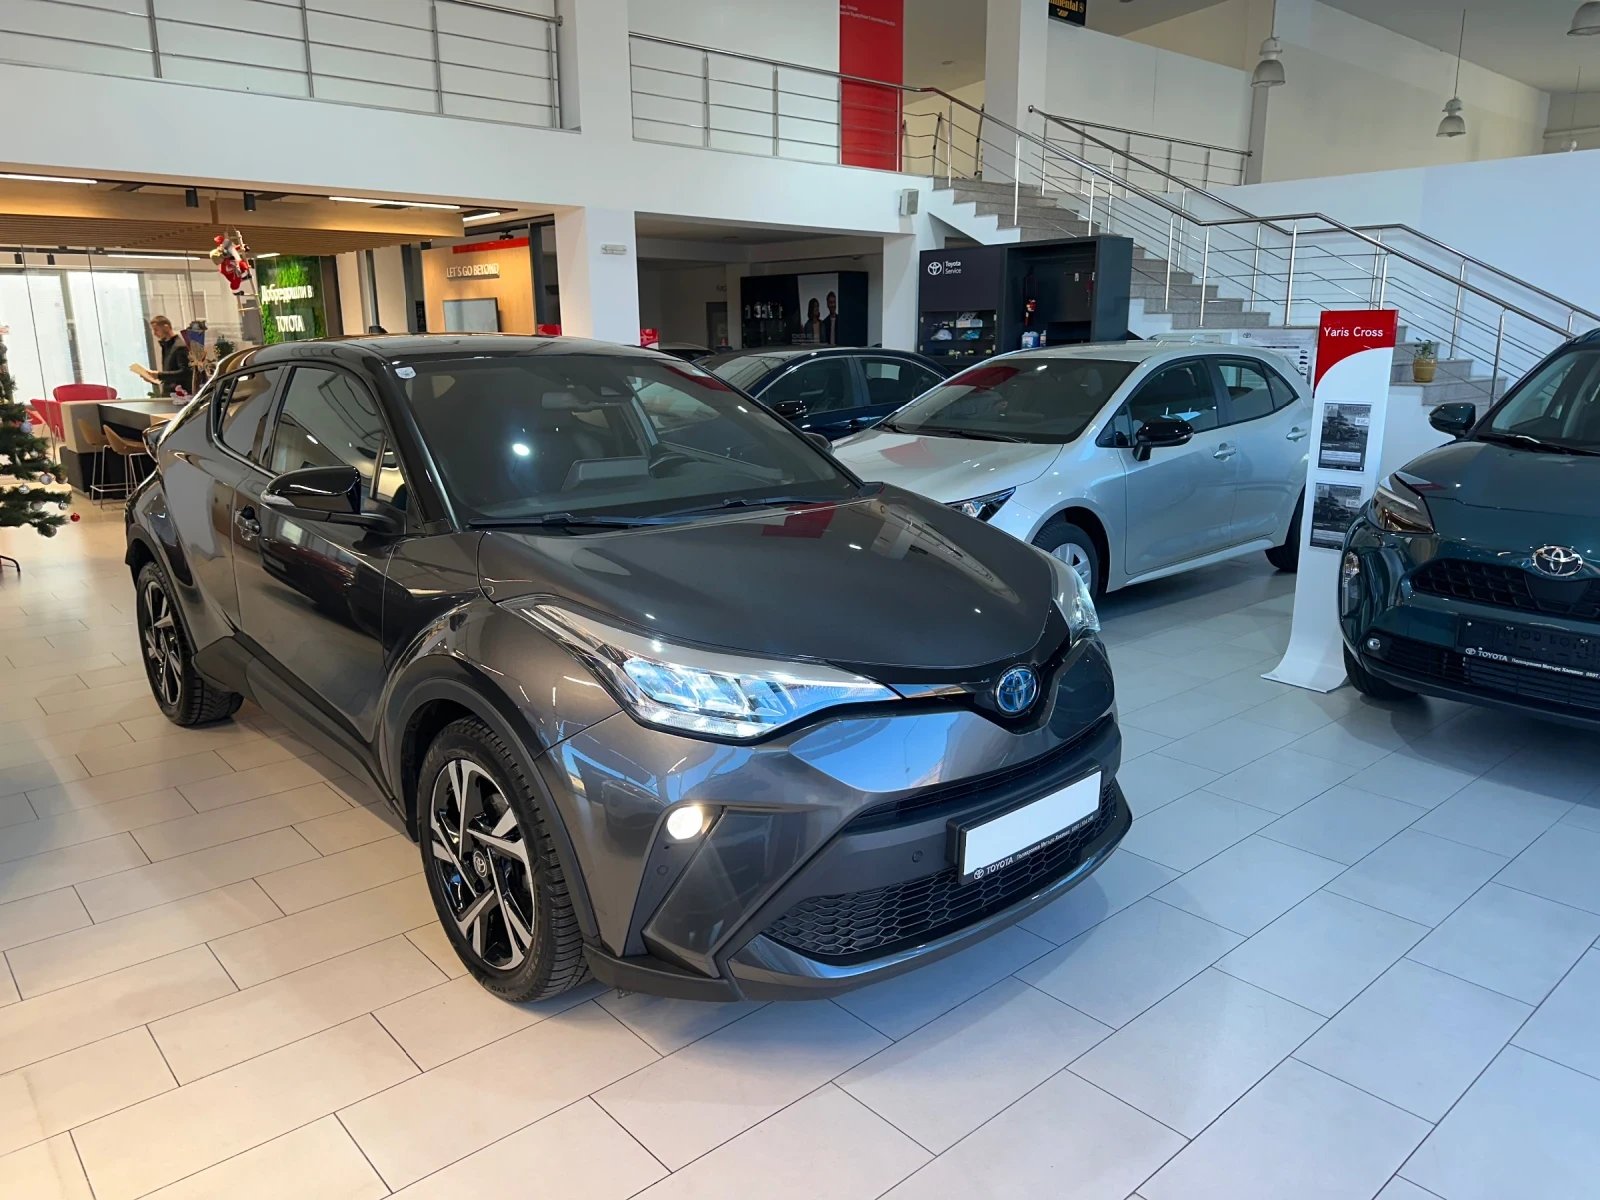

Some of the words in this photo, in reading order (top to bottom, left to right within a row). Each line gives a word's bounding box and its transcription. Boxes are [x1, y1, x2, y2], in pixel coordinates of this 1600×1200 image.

[462, 265, 473, 276] GO
[473, 263, 499, 275] BEYOND
[945, 260, 962, 268] Toyota
[261, 284, 307, 305] Добредошли
[275, 315, 306, 332] TOYOTA
[1323, 326, 1350, 337] Yaris
[1353, 326, 1384, 337] Cross
[1478, 650, 1508, 662] TOYOTA
[986, 856, 1014, 875] TOYOTA
